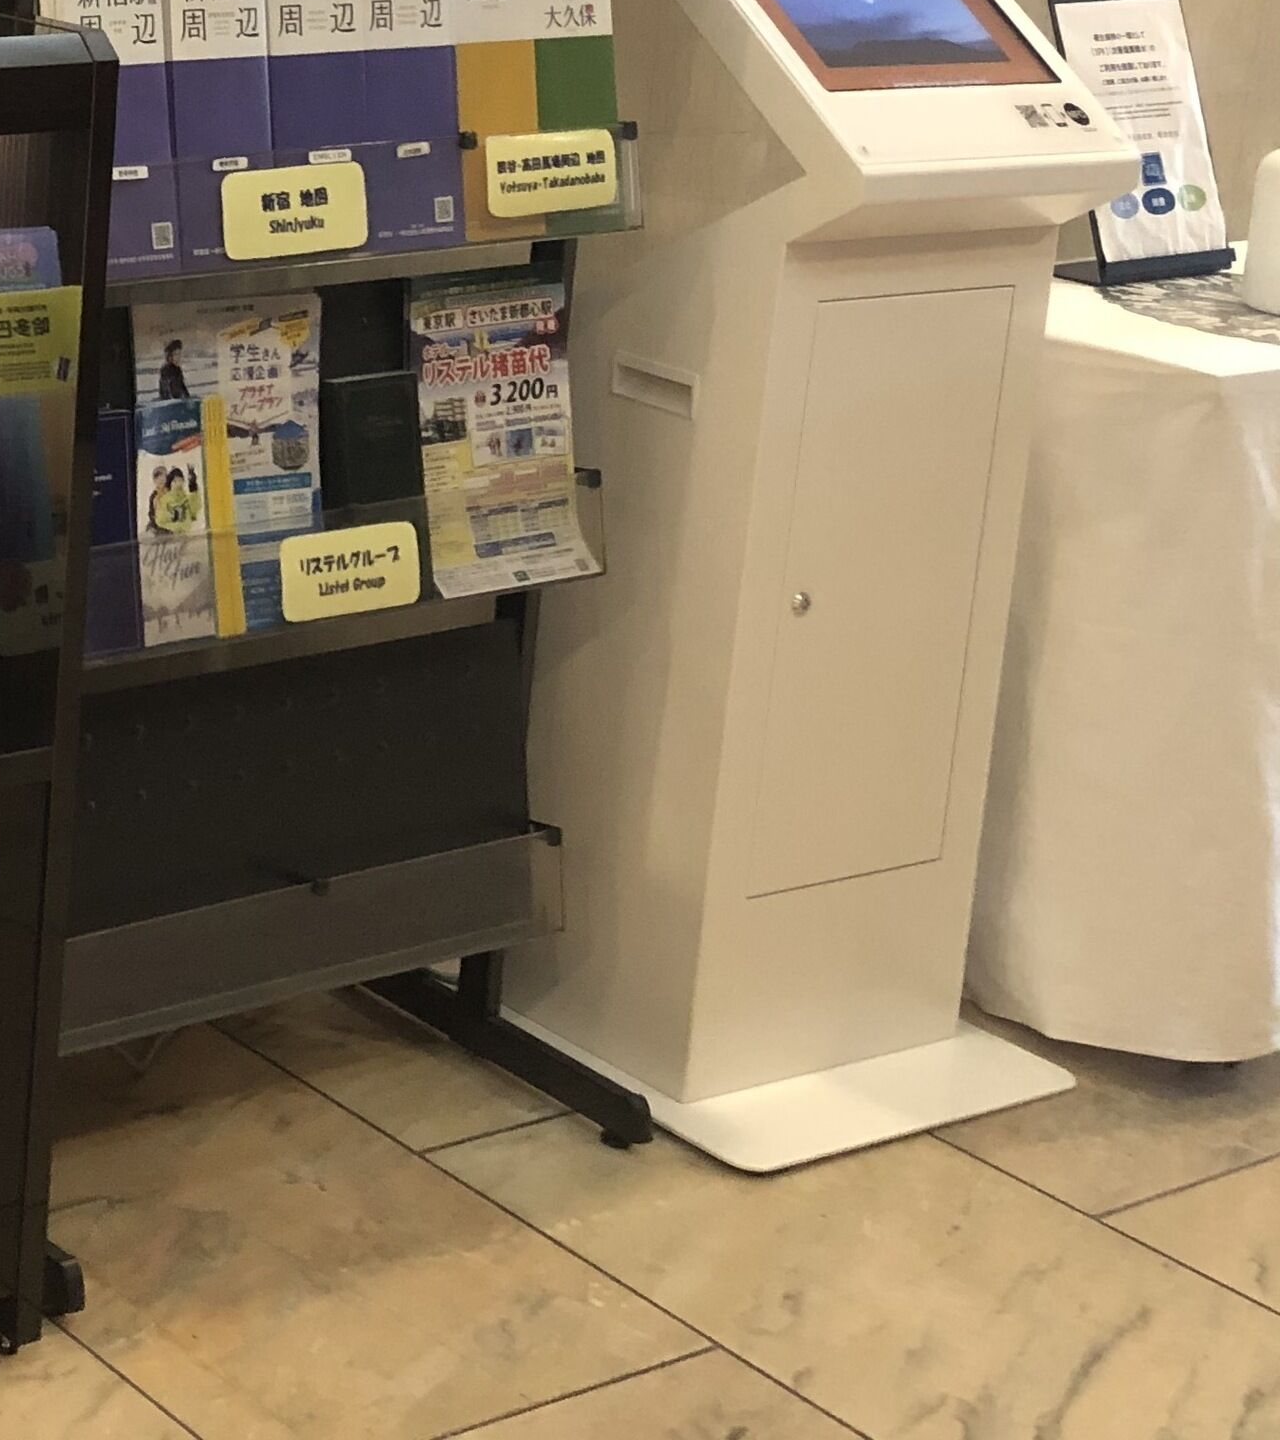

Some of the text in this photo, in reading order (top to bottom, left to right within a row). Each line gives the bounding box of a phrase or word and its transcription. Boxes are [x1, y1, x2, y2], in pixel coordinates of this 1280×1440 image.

[543, 3, 597, 30] 大久保
[261, 186, 329, 212] 新宿 地図
[269, 215, 325, 234] Shinjyuku
[423, 312, 456, 330] 東京駅
[300, 545, 400, 576] リステルグループ
[319, 578, 350, 596] Listel
